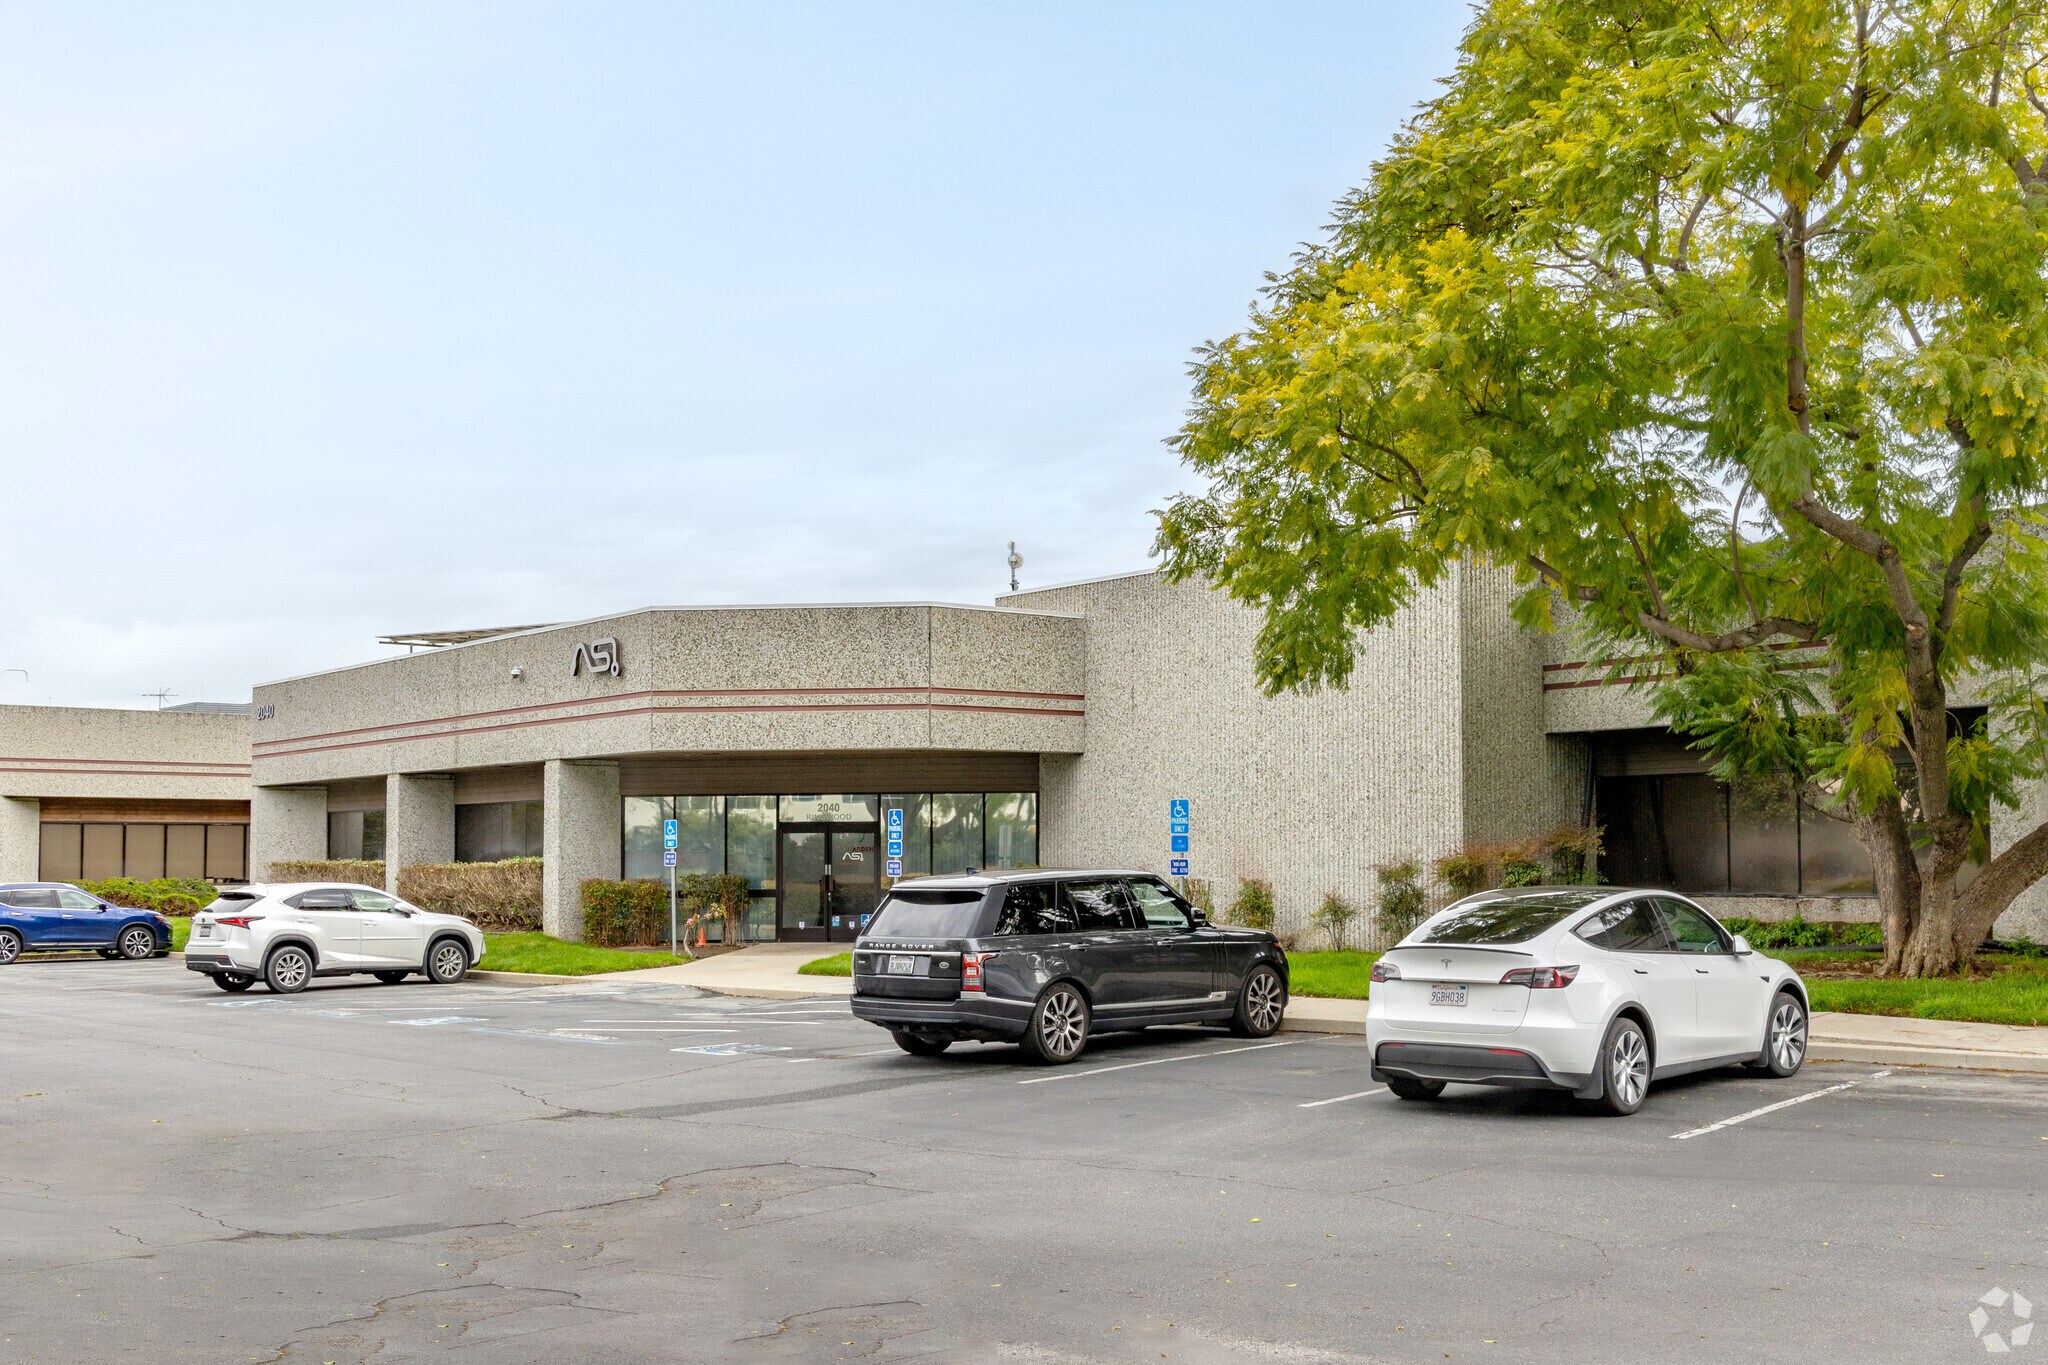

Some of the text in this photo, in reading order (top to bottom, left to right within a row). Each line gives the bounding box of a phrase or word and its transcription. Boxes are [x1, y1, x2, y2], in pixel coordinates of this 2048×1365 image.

[257, 704, 275, 721] 2040
[817, 802, 840, 813] 2040
[1171, 817, 1189, 825] PARKING
[1174, 825, 1186, 833] ONLY
[868, 942, 934, 951] RANGE ROVER
[1431, 991, 1465, 1003] 9GBH038
